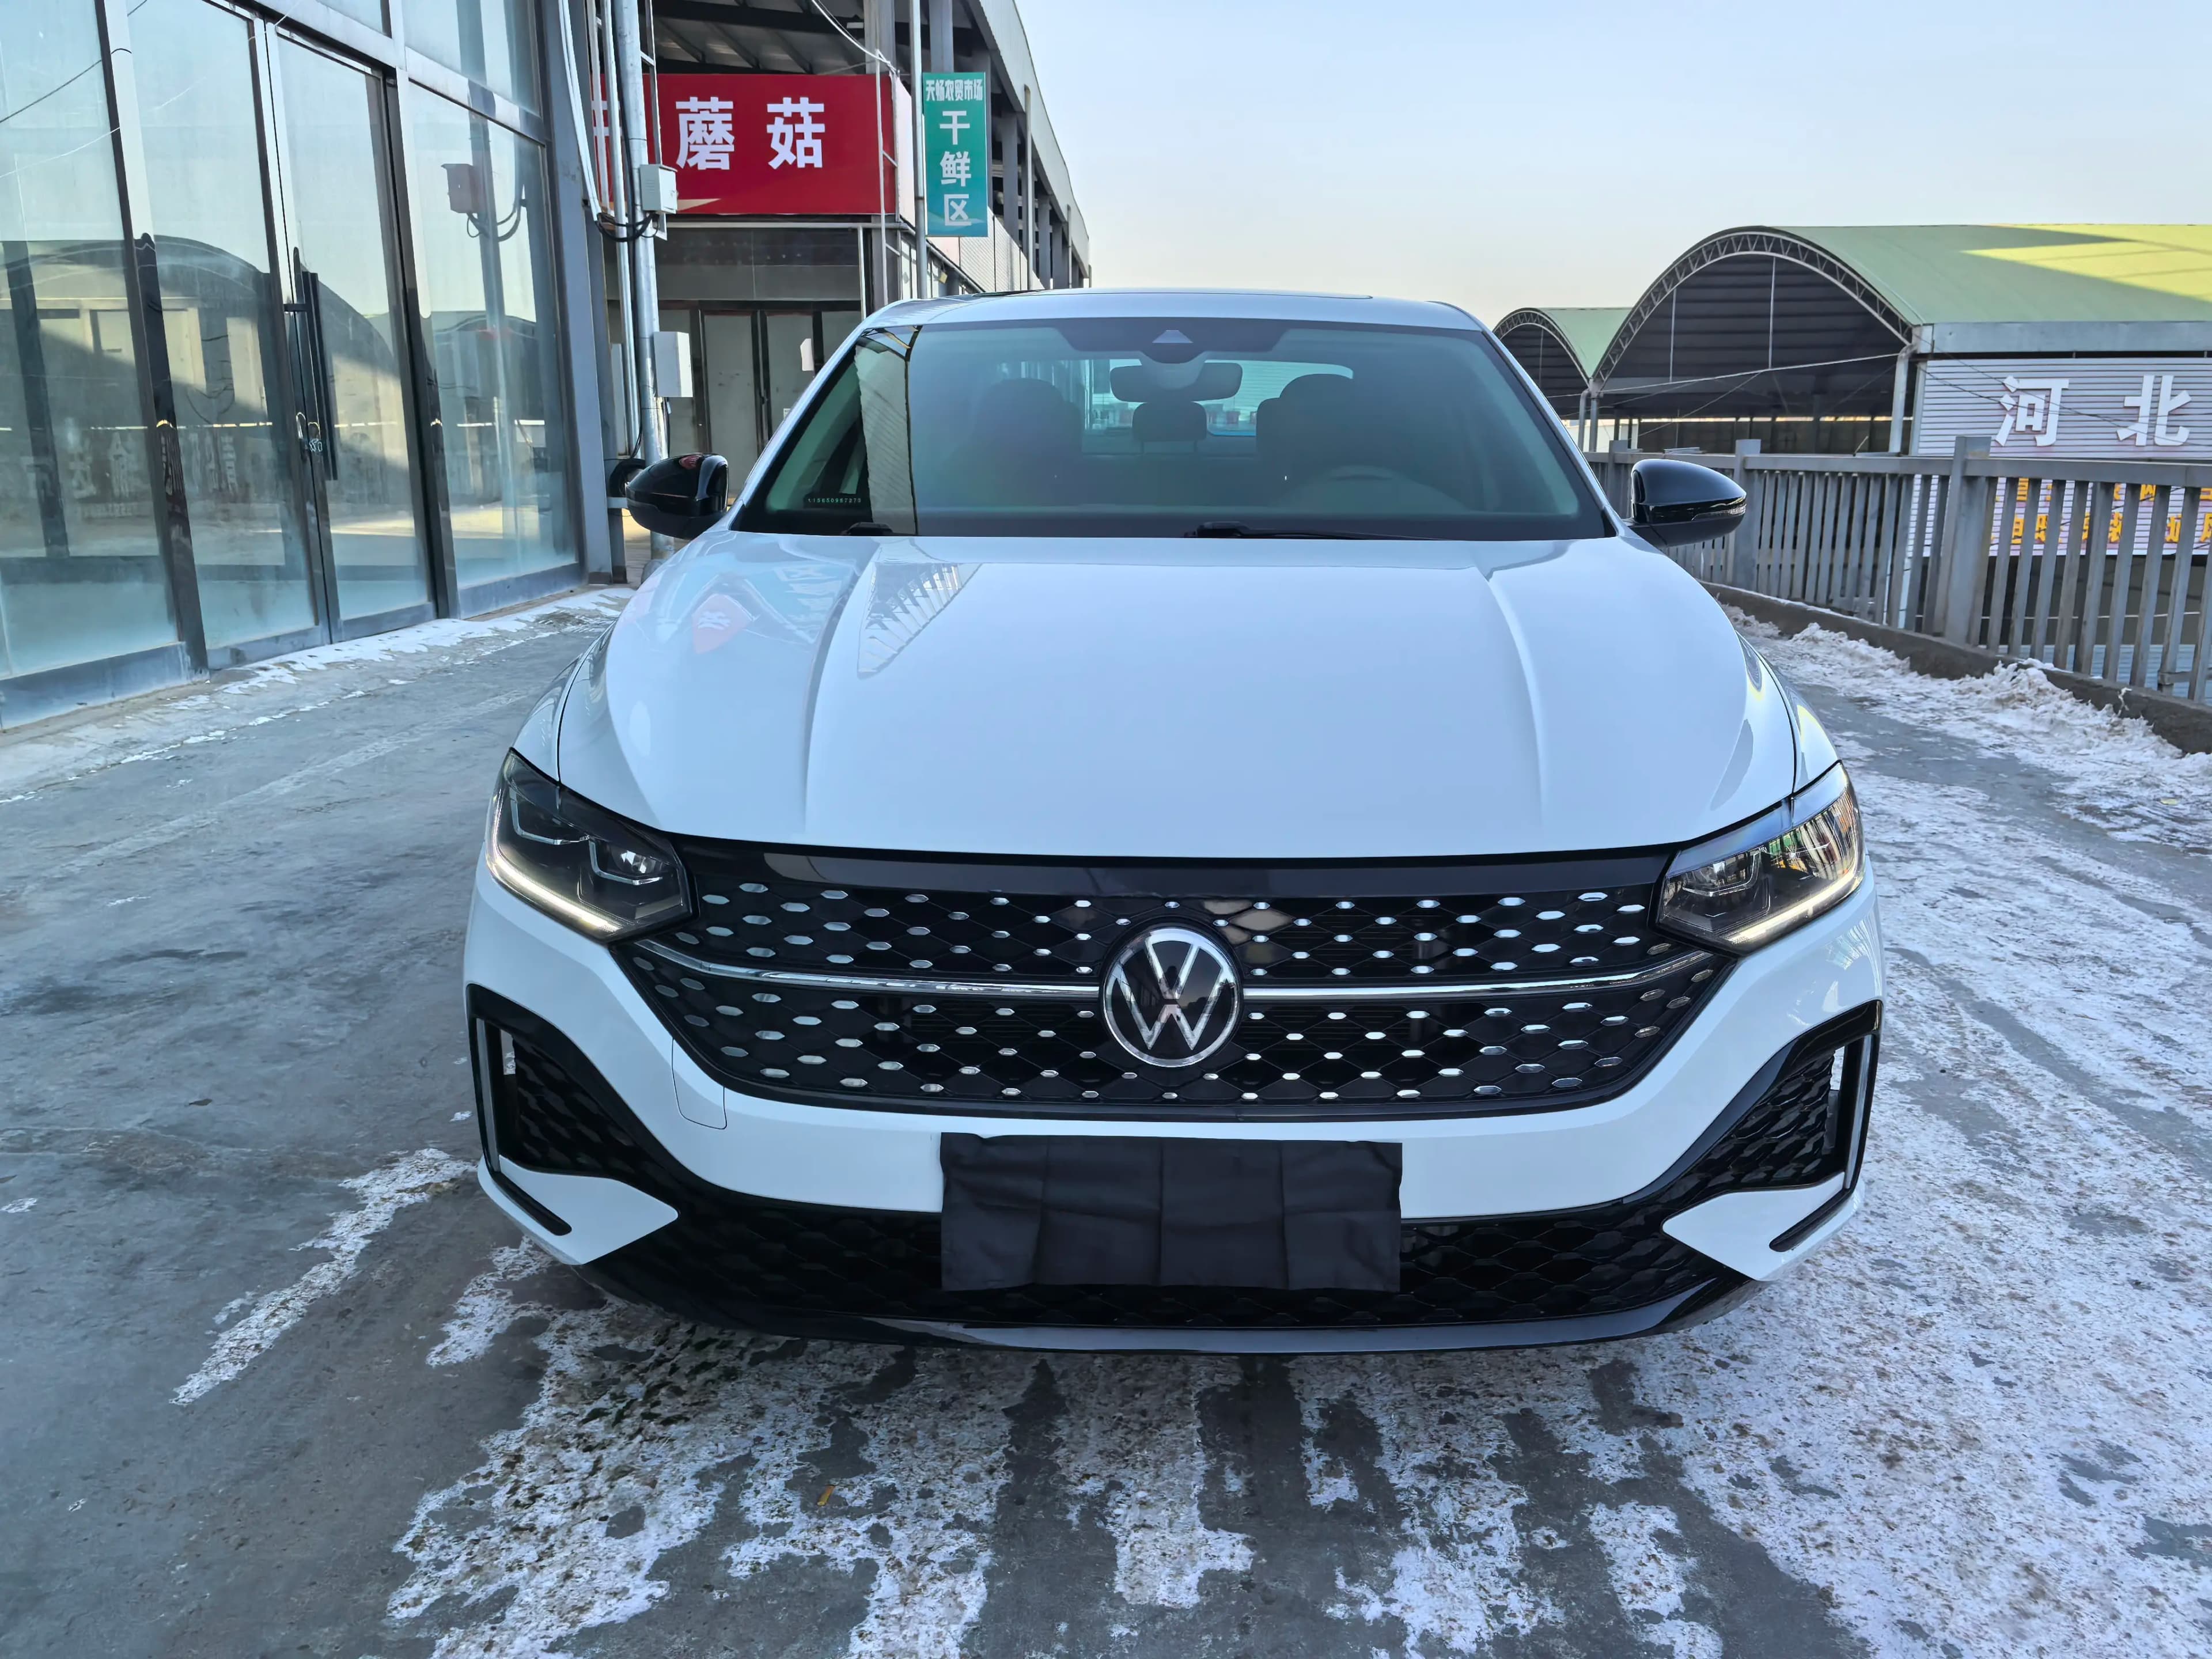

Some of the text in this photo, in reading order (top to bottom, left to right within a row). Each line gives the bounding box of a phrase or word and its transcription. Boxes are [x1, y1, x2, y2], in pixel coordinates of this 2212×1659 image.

[591, 96, 825, 171] 蘑菇
[940, 110, 972, 226] 干鲜区
[1994, 374, 2192, 446] 河北
